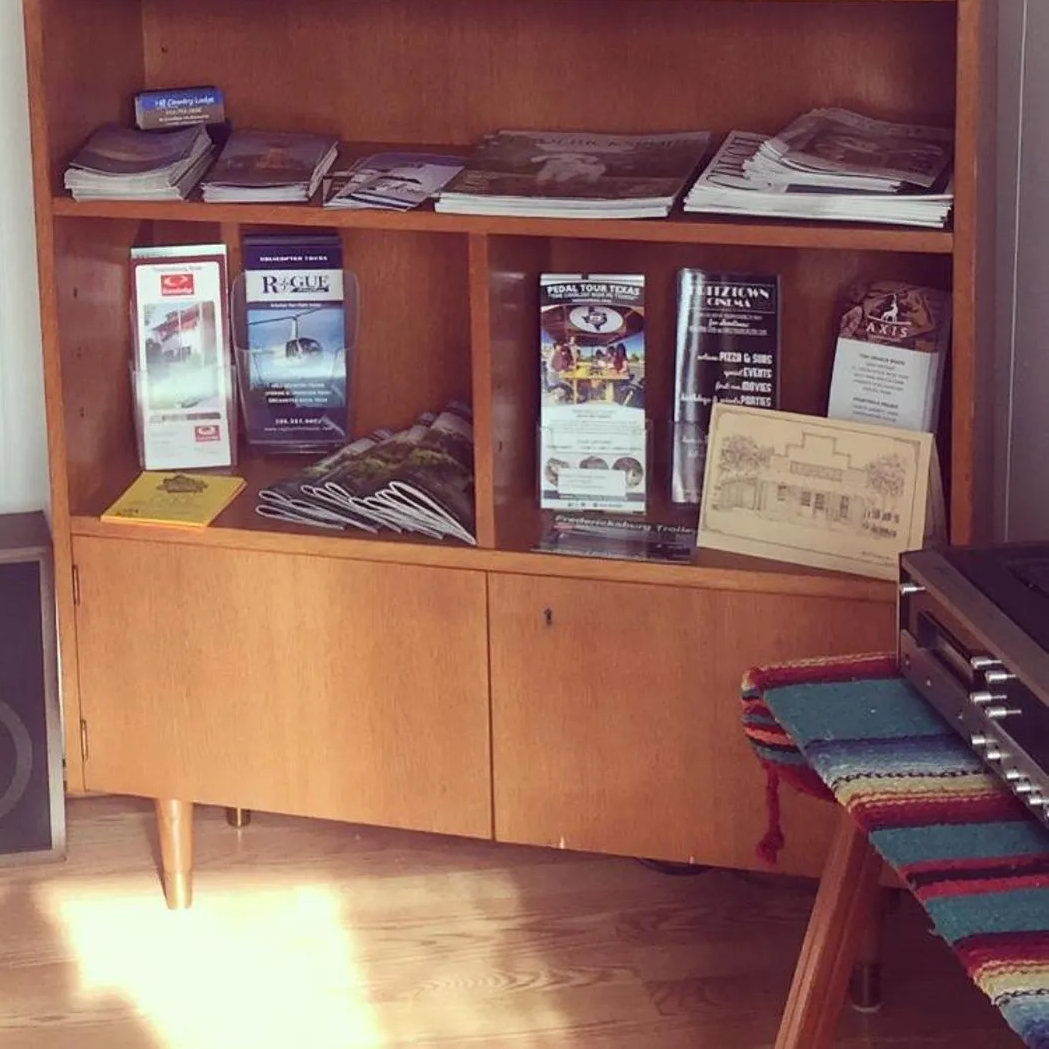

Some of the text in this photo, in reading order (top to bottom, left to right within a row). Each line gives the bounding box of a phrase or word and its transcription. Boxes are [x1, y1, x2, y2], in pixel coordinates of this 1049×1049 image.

[547, 284, 640, 296] PEDAL TOUR TEXAS
[688, 285, 770, 299] ITZTOWN
[706, 297, 751, 308] CINEMA
[866, 322, 909, 338] AXIS
[719, 351, 742, 362] PIZZA
[743, 367, 772, 378] EVENTS
[741, 381, 772, 392] MOVIES
[555, 514, 696, 534] Fredericksburg Trolle
